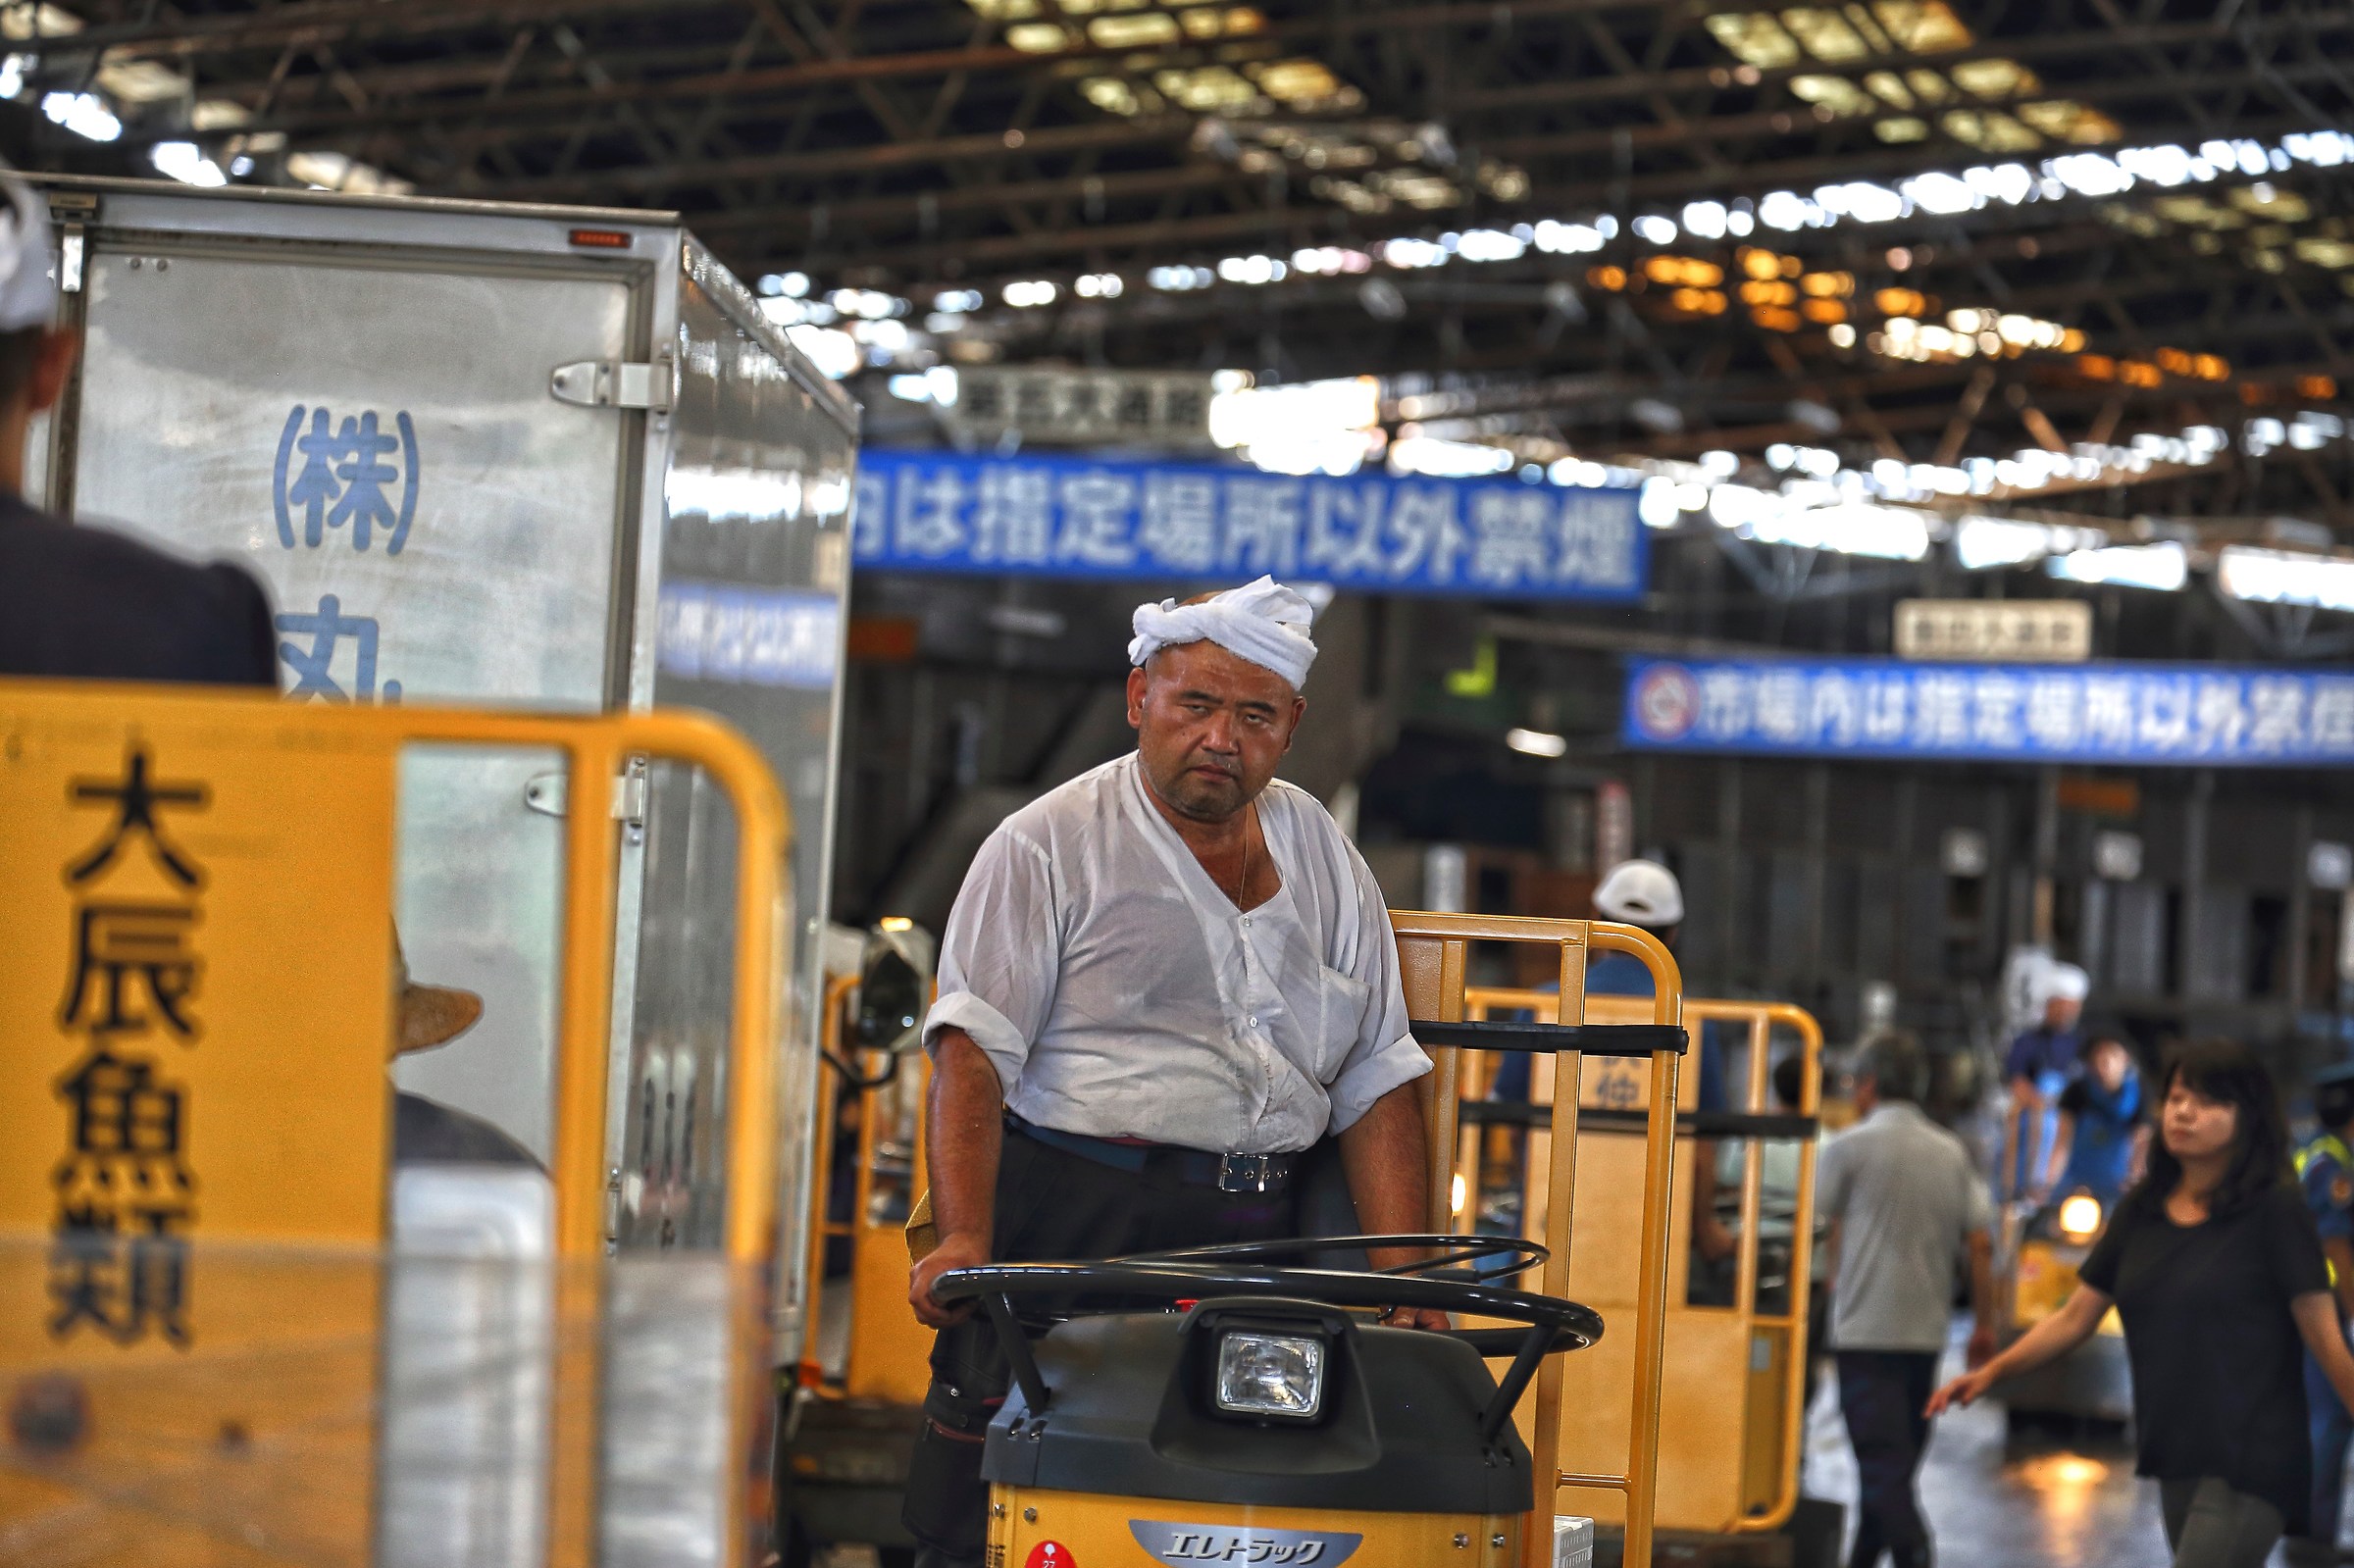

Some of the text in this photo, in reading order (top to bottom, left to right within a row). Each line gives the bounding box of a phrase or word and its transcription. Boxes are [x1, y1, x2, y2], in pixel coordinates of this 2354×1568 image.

[1163, 1532, 1325, 1565] エレトラック
